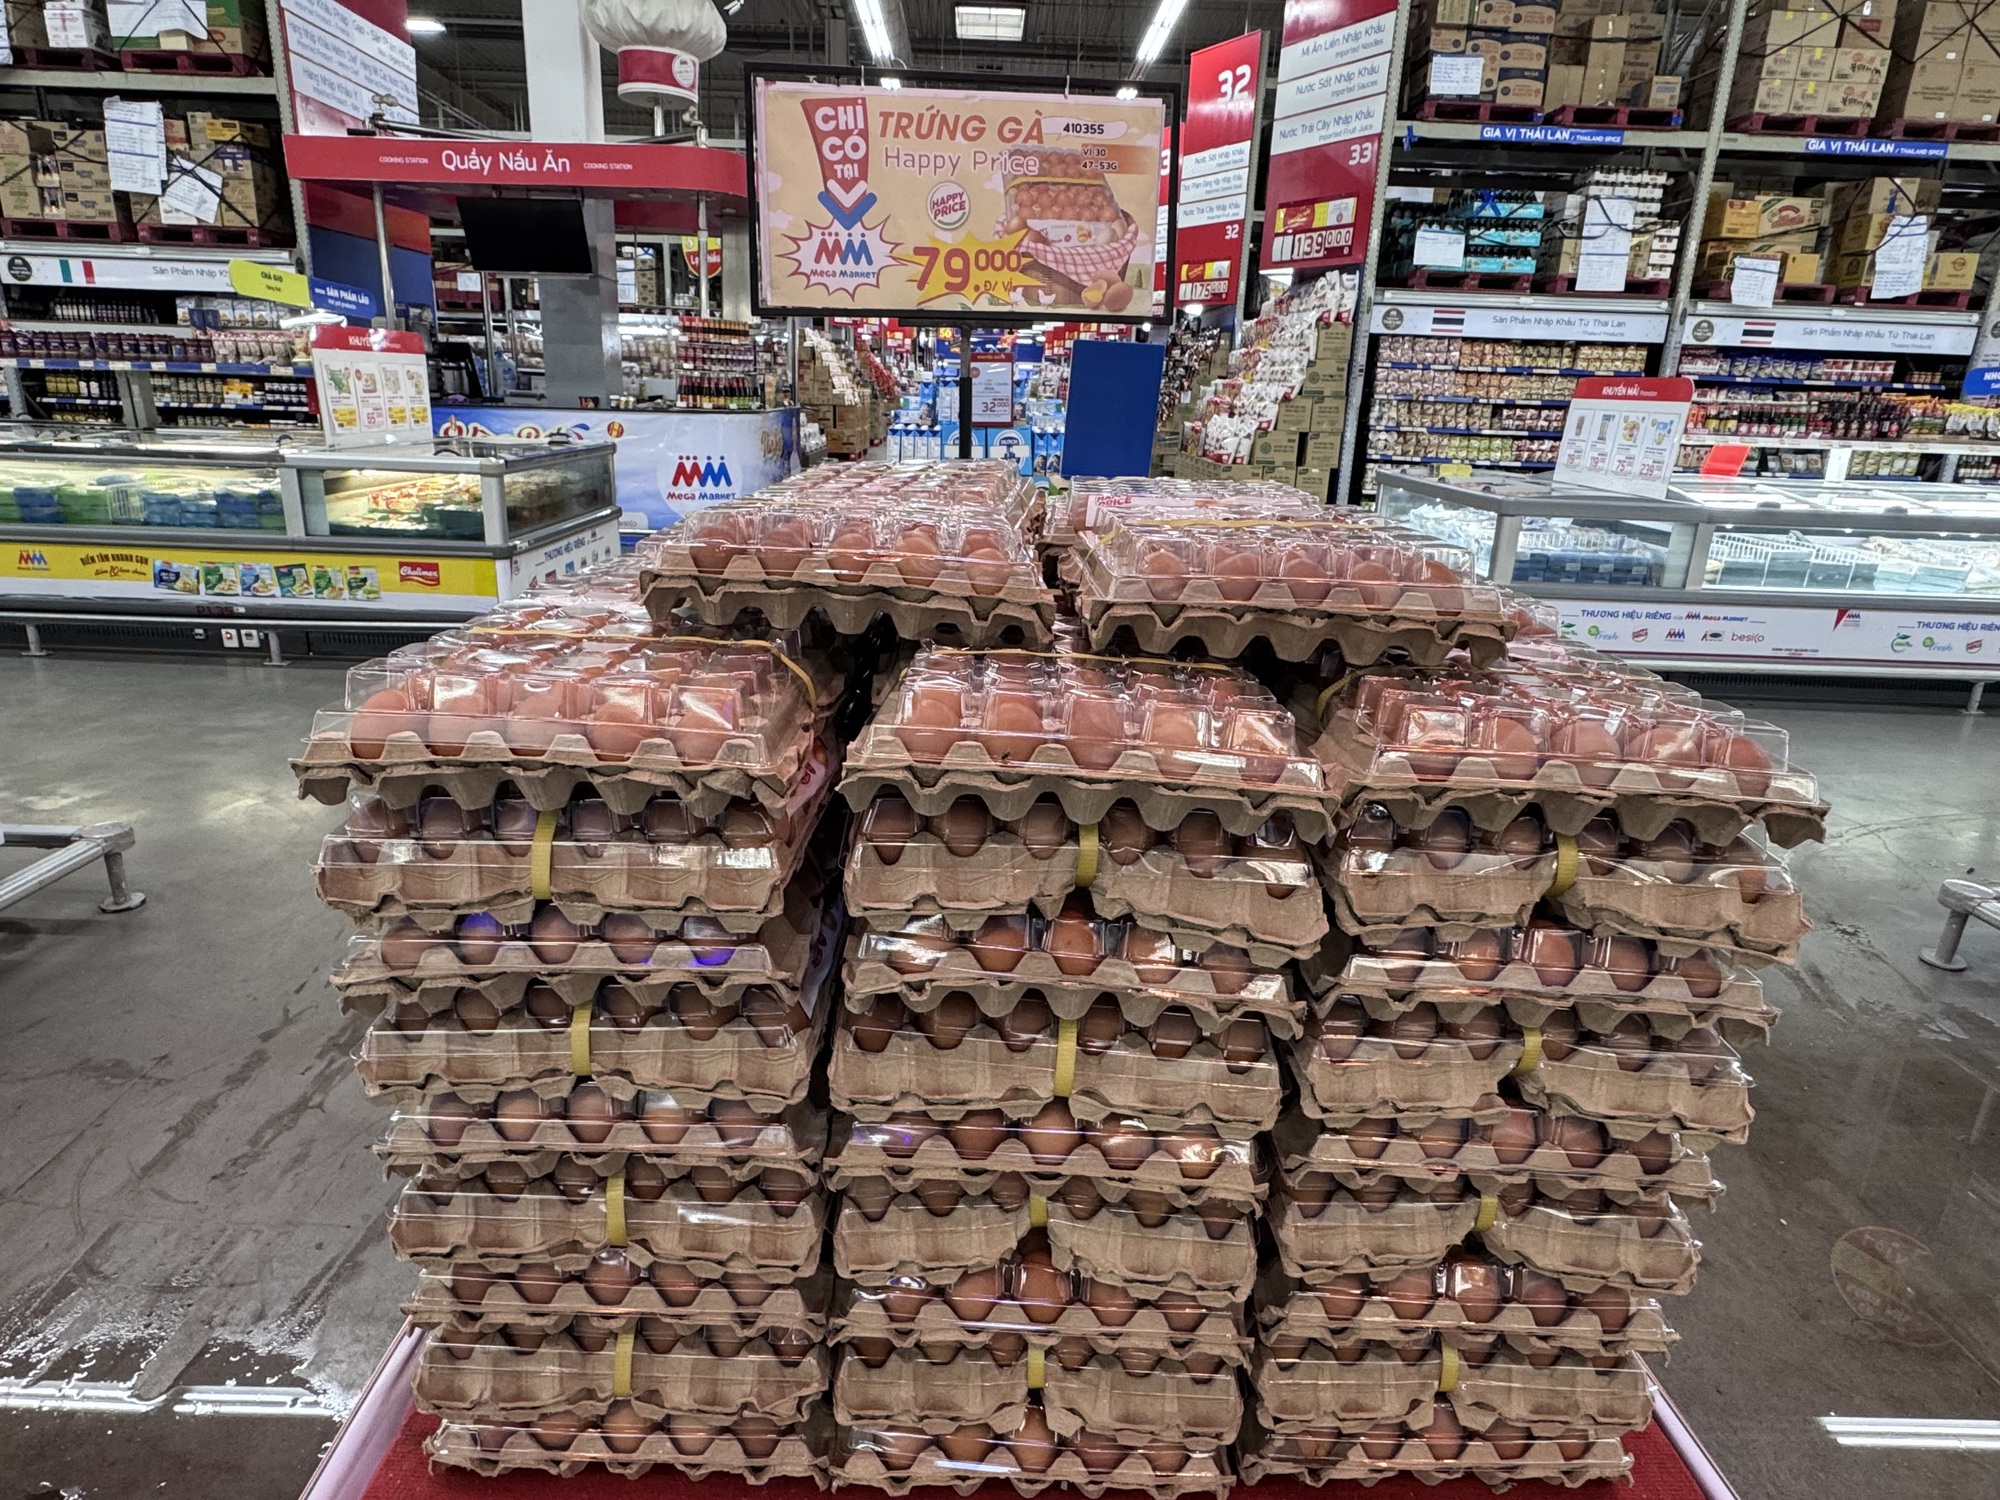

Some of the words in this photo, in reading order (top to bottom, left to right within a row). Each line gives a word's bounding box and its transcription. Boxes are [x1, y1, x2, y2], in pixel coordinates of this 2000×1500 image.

[1217, 64, 1251, 105] 32
[815, 99, 865, 132] CHỈ
[879, 104, 986, 143] TRỨNG
[997, 109, 1044, 144] GÀ
[1063, 123, 1105, 135] 410355
[1483, 127, 1501, 138] GIA
[1505, 128, 1516, 141] VỊ
[1520, 127, 1544, 140] THÁI
[1547, 129, 1570, 140] LAN
[822, 129, 867, 161] CÓ
[1808, 141, 1826, 150] GIA
[1830, 141, 1841, 153] VỊ
[1845, 140, 1869, 152] THÁI
[1872, 143, 1895, 154] LAN
[1095, 148, 1107, 157] 30
[1348, 142, 1372, 166] 33
[379, 156, 404, 164] COOKING
[442, 148, 492, 175] Quầy
[499, 149, 537, 172] Nấu
[543, 149, 570, 173] Ăn
[583, 162, 608, 170] COOKING
[884, 147, 961, 176] Happy
[973, 150, 1039, 175] Price
[1081, 161, 1118, 171] 47-53G
[834, 163, 859, 181] TẠI
[932, 191, 965, 210] HAPPY
[933, 200, 966, 220] PRICE
[1224, 223, 1240, 240] 32
[810, 268, 837, 278] Mega
[839, 269, 877, 279] Market
[1492, 315, 1507, 323] Sản
[1509, 315, 1532, 324] Phẩm
[1802, 327, 1818, 336] Sản
[1819, 328, 1841, 337] Phẩm
[1919, 332, 1935, 340] Lan
[667, 492, 696, 500] Mega
[698, 492, 736, 500] Market
[1581, 609, 1620, 619] THƯƠNG
[1622, 611, 1644, 621] HIỆU
[1645, 612, 1672, 620] RIÊNG
[1917, 621, 1956, 630] THƯƠNG
[1958, 621, 1979, 632] HIỆU
